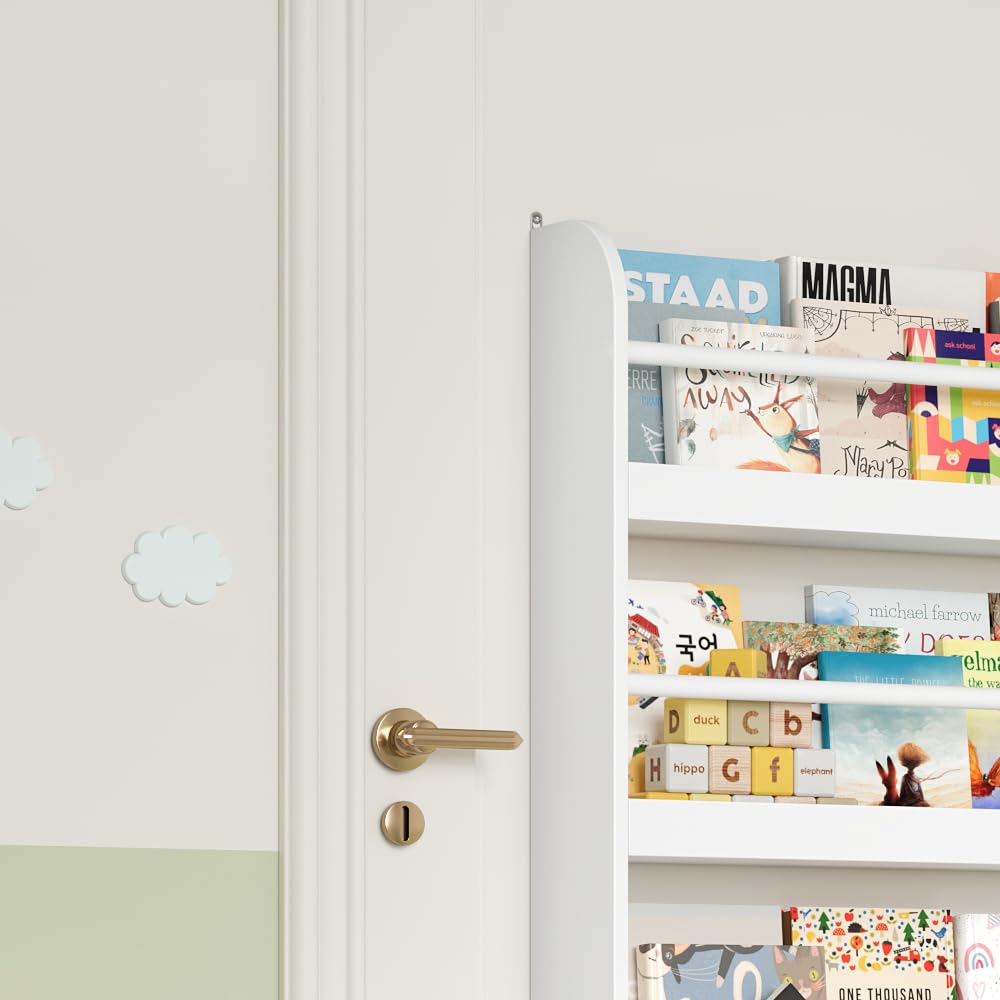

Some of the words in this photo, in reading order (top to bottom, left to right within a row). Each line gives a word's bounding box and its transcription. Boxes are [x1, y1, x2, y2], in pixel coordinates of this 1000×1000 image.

[802, 261, 892, 305] MAGMA
[944, 341, 976, 350] ask.school
[683, 384, 752, 412] AWAY
[840, 445, 885, 478] Mary
[869, 602, 929, 620] michael
[932, 604, 982, 622] farrow
[675, 633, 718, 662] 국어
[968, 677, 983, 688] the
[668, 709, 681, 734] D
[693, 714, 720, 725] duck
[742, 710, 760, 735] C
[784, 709, 803, 736] b
[650, 757, 661, 783] H
[673, 762, 705, 775] hippo
[721, 758, 741, 783] G
[769, 756, 780, 783] f
[800, 767, 833, 776] elephant
